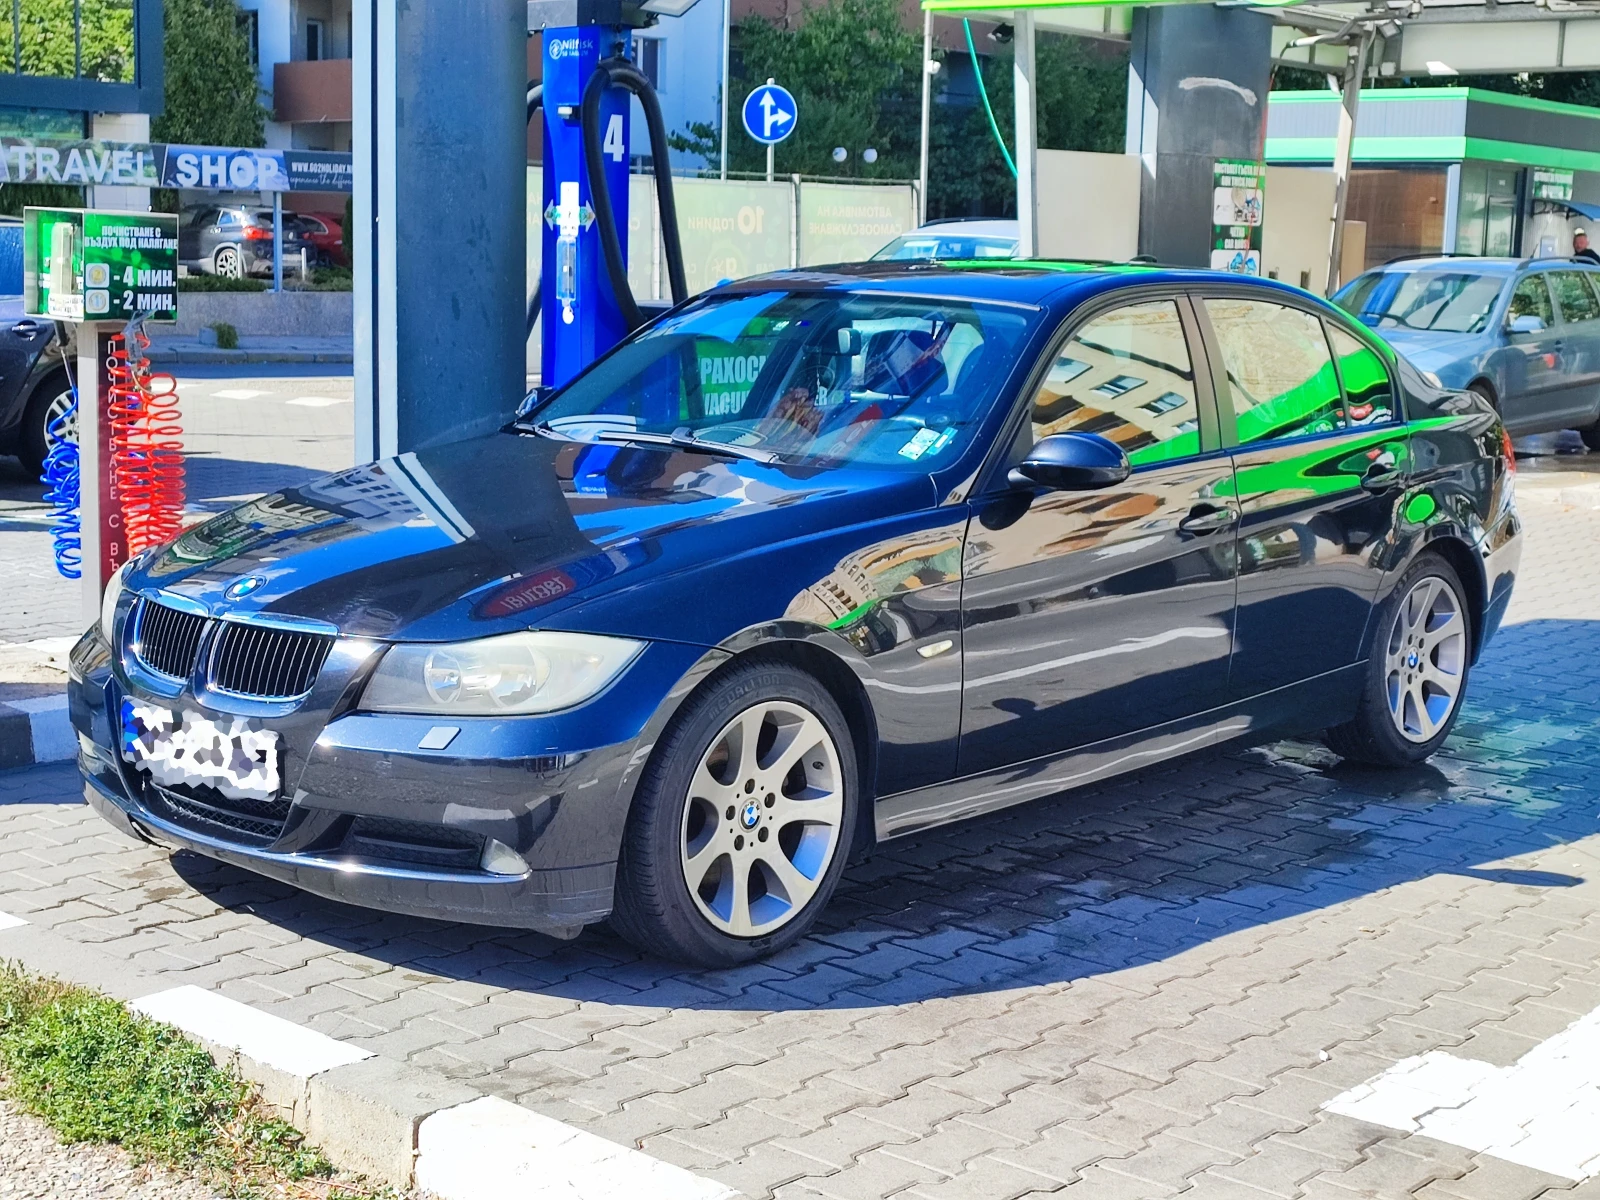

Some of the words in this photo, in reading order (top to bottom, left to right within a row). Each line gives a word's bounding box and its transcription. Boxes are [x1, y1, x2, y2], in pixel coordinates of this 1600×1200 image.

[562, 38, 594, 49] Nilfisk
[602, 114, 625, 162] 4
[9, 145, 160, 187] TRAVEL
[175, 153, 279, 191] SHOP
[101, 225, 154, 237] ПОЧИСТВАНЕ
[154, 227, 162, 237] С
[84, 236, 118, 249] ВЪЗДУХ
[118, 237, 137, 249] ПОД
[137, 238, 178, 249] НАЛЯГАНЕ
[123, 266, 134, 287] 4
[137, 269, 176, 287] МИН.
[122, 290, 134, 310] 2
[137, 294, 176, 311] МИН.
